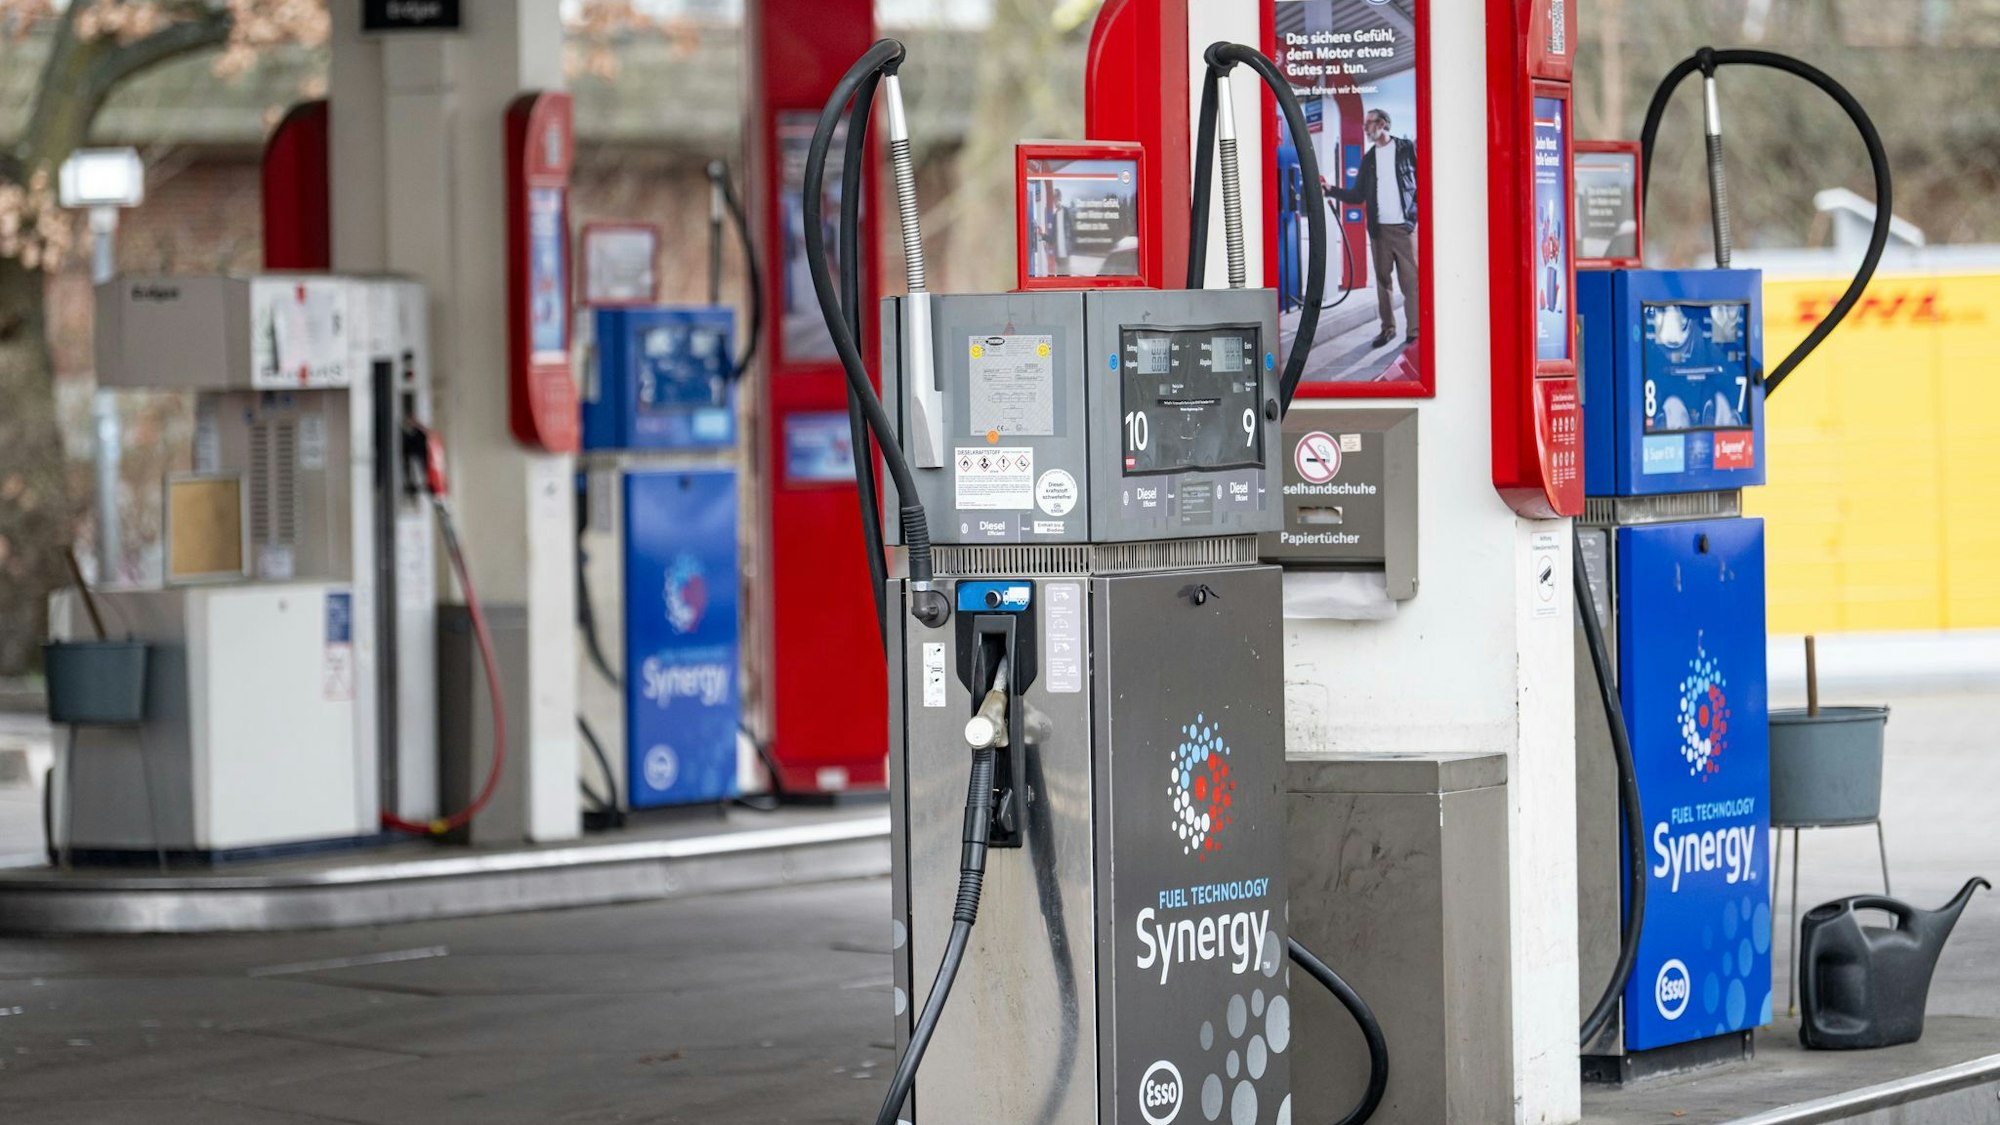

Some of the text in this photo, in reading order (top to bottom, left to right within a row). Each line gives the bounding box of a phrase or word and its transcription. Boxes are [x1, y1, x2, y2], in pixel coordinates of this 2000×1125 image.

[1286, 28, 1395, 45] Das sichere Gefühl,
[1286, 47, 1394, 60] dem Motor etwas
[1287, 62, 1368, 76] Gutes zu tun.
[1312, 86, 1337, 95] fahren
[1338, 85, 1351, 93] wir
[1645, 379, 1657, 417] 8
[1736, 376, 1748, 412] 7
[1125, 411, 1148, 450] 10
[1242, 408, 1256, 447] 9
[1137, 488, 1157, 500] Diesel
[1229, 482, 1248, 495] Diesel
[1283, 483, 1376, 494] selhandschuhe
[979, 521, 1005, 531] Diesel
[1280, 532, 1360, 546] Papiertücher
[642, 655, 729, 709] Synergy
[1671, 797, 1755, 825] FUEL TECHNOLOGY
[1653, 822, 1756, 893] Synergy
[1159, 878, 1269, 909] FUEL TECHNOLOGY
[1136, 906, 1270, 986] Synergy
[1661, 976, 1685, 1002] Esso
[1146, 1079, 1177, 1108] Esso
